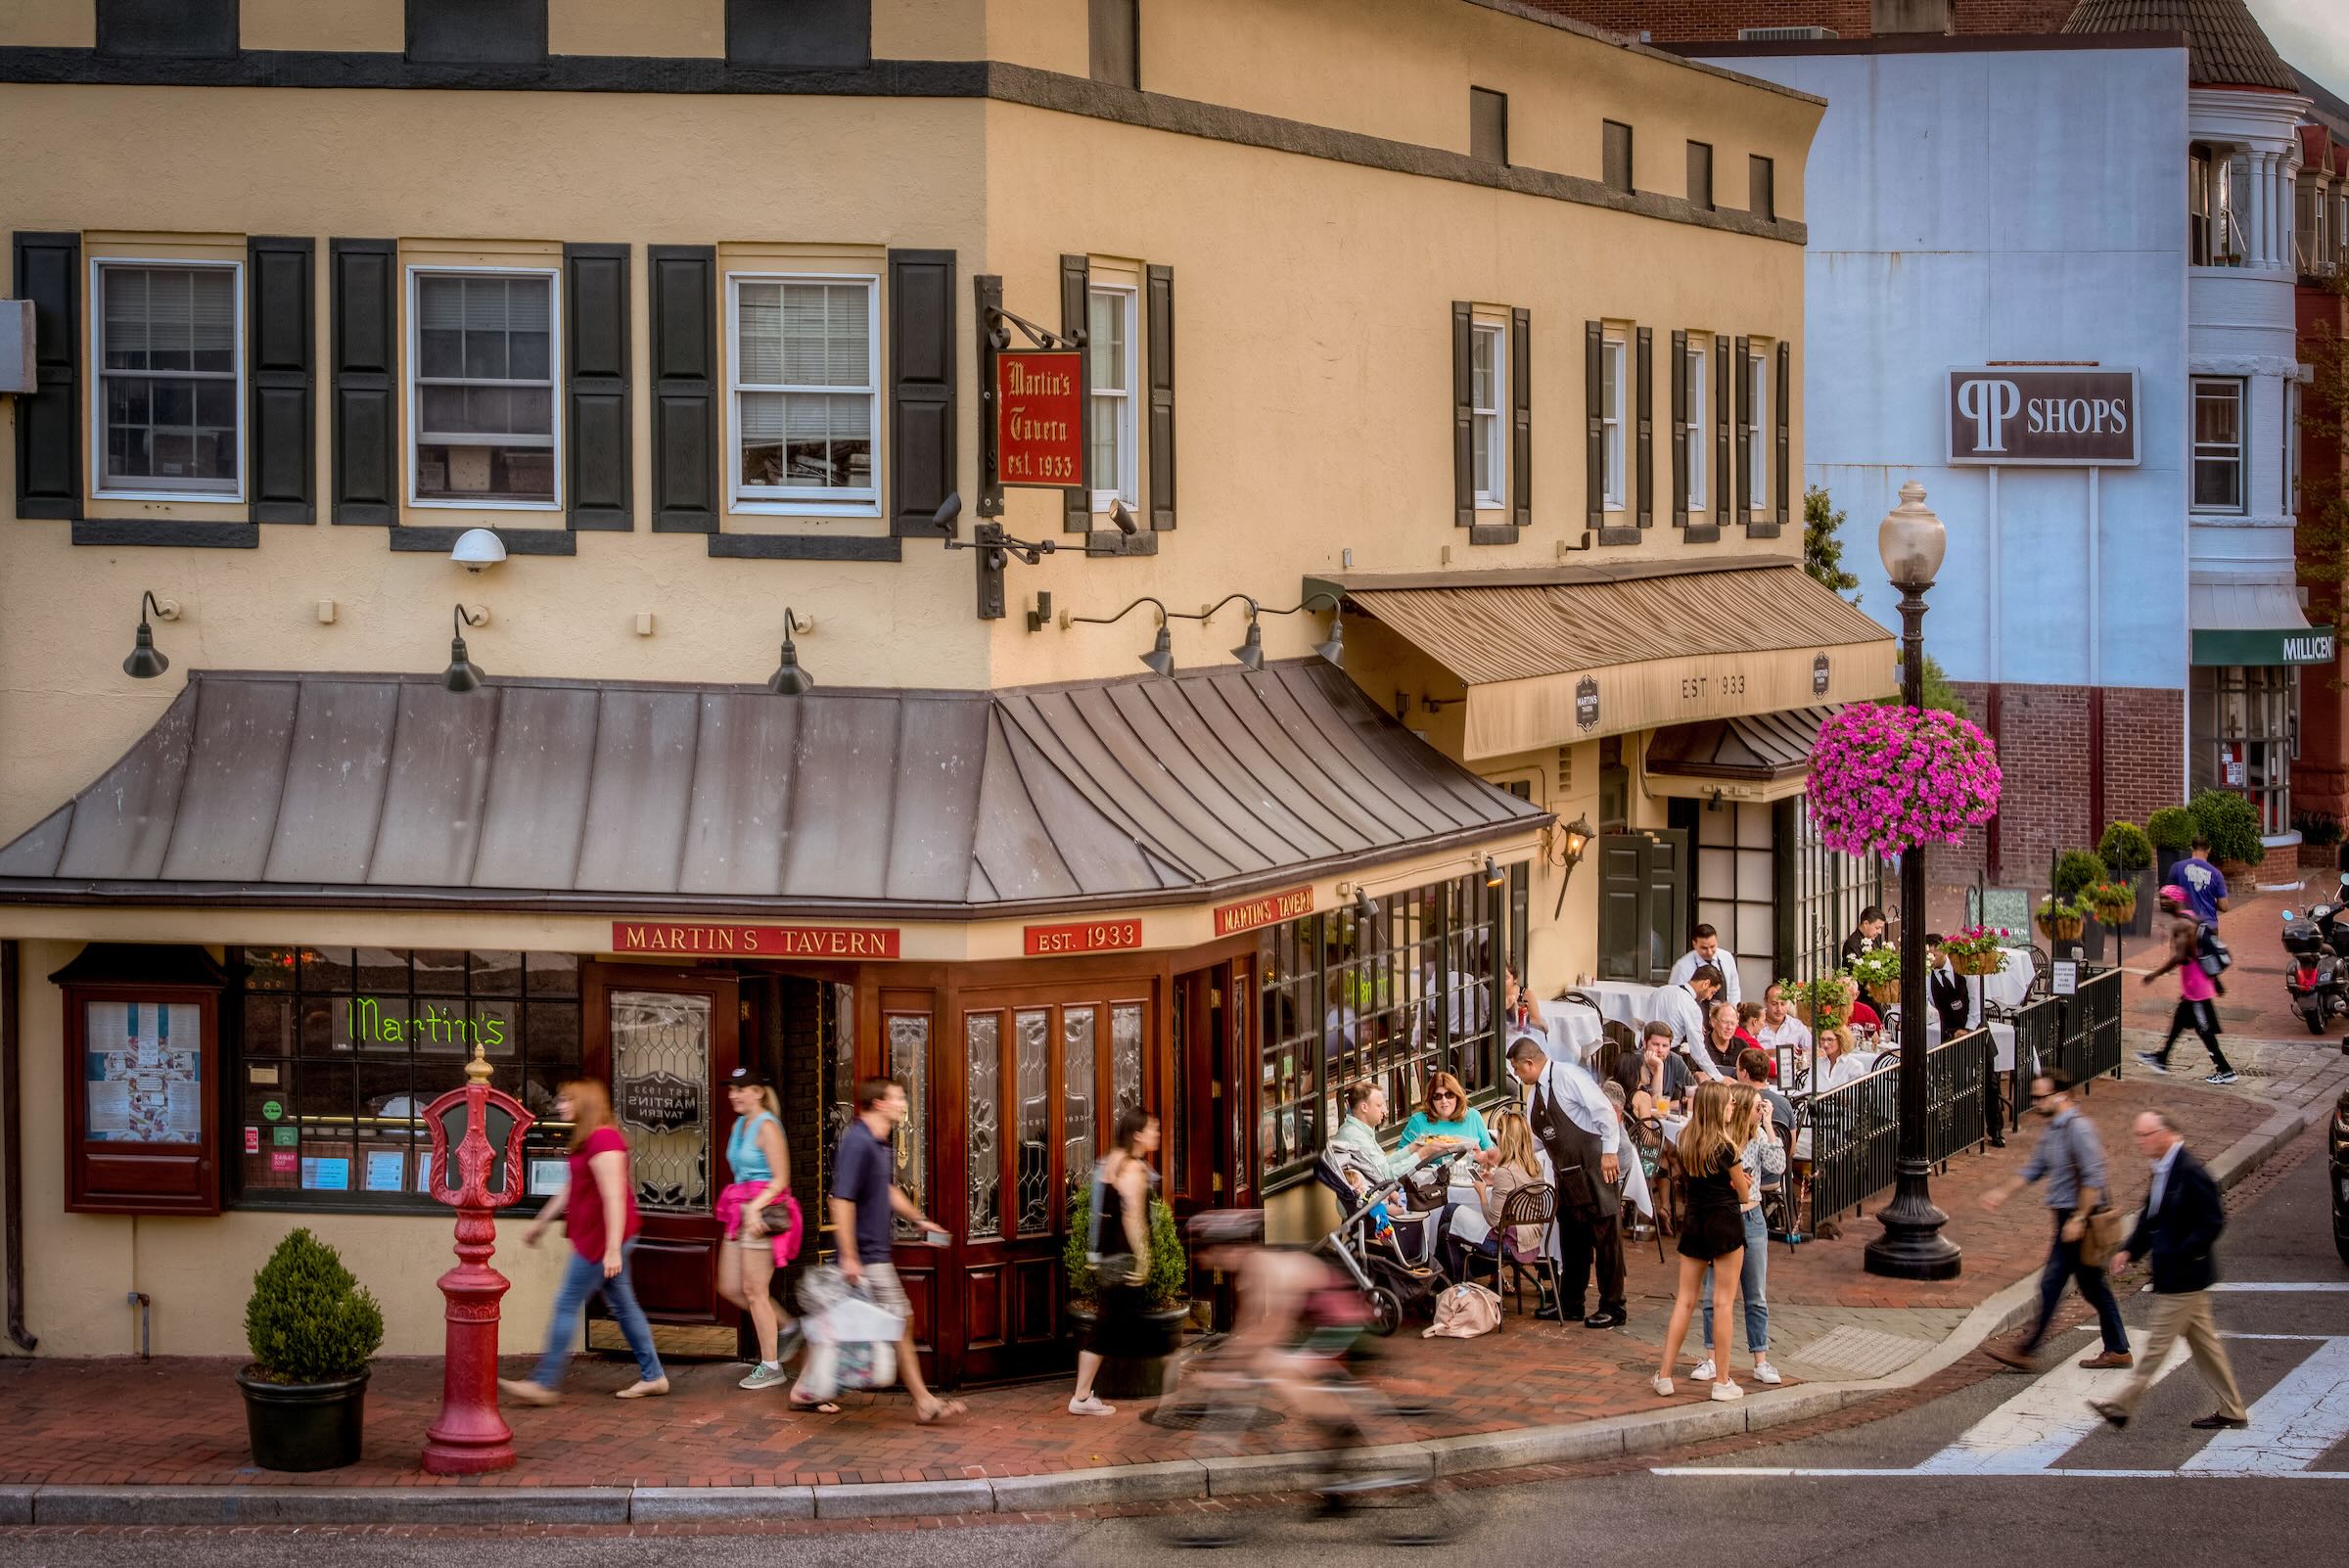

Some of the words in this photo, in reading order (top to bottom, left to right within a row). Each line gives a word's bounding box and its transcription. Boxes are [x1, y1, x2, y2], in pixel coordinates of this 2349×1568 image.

[1006, 360, 1072, 396] Martin's
[1010, 406, 1068, 441] Tavern
[2027, 397, 2127, 434] SHOPS
[1038, 454, 1073, 478] 1933
[1681, 677, 1707, 699] EST
[1222, 899, 1271, 931] MARTIN'S
[1276, 891, 1313, 917] TAVERN
[626, 926, 759, 950] MARTIN'S
[780, 931, 887, 955] TAVERN
[1038, 933, 1077, 951] EST.
[1086, 925, 1134, 947] 1933
[346, 997, 505, 1044] Martin's
